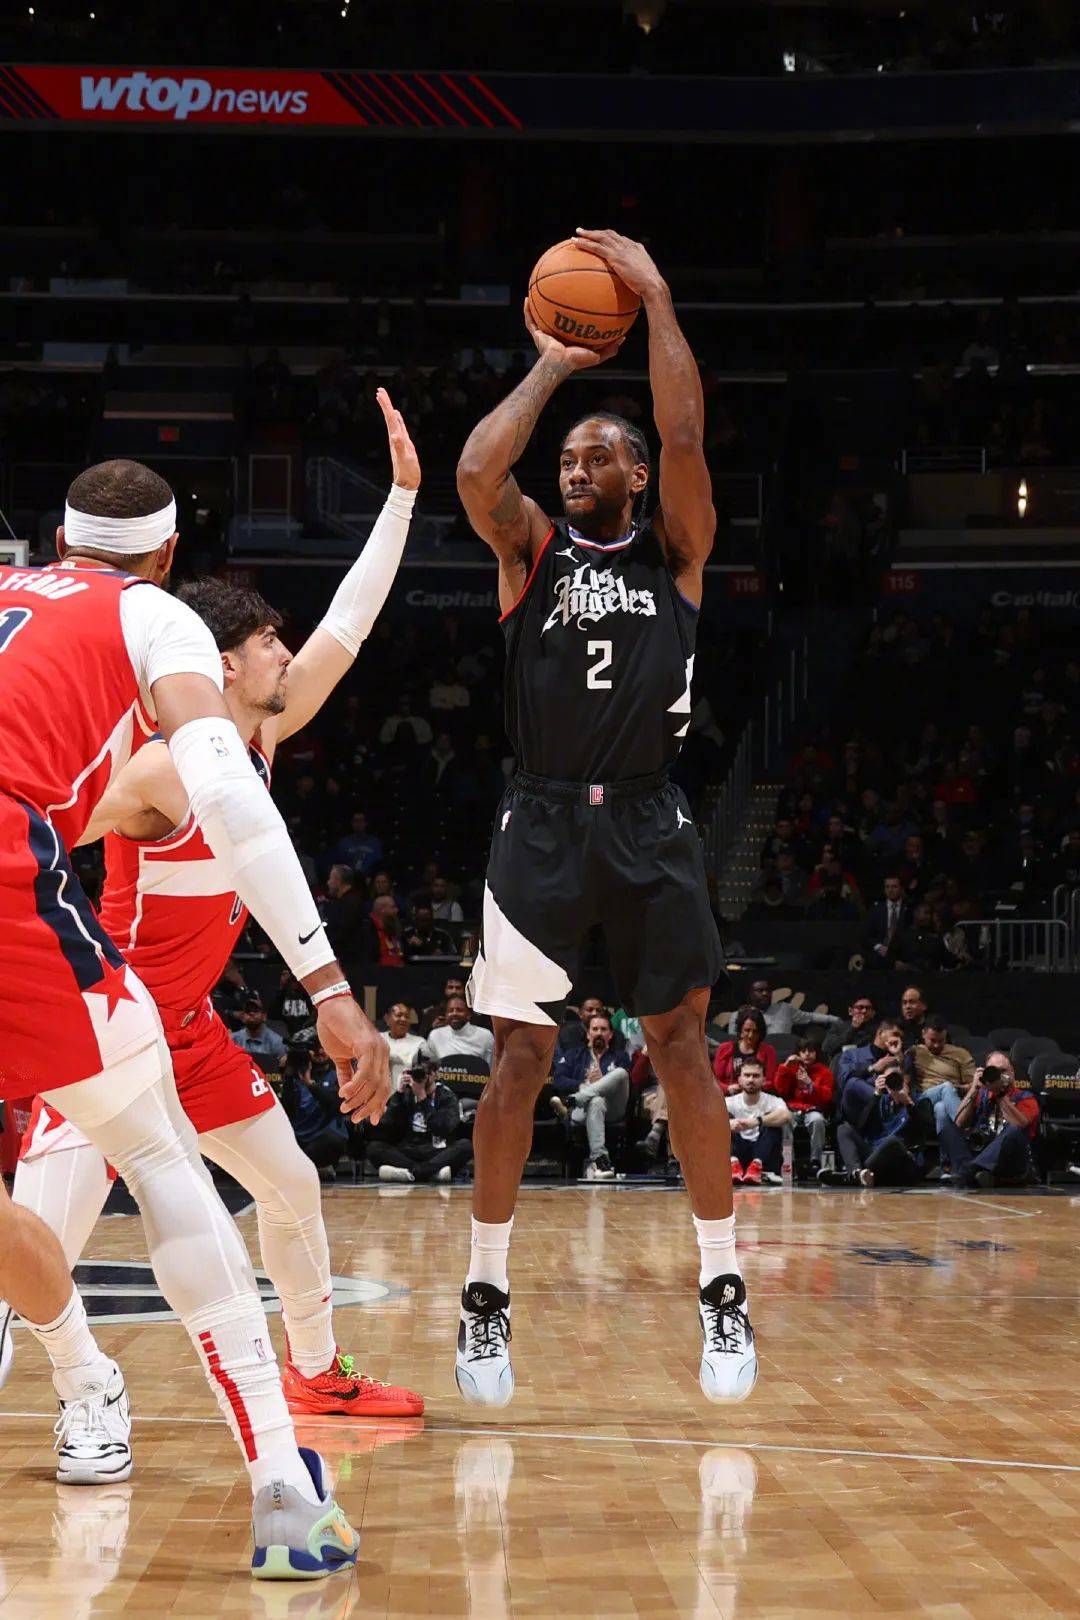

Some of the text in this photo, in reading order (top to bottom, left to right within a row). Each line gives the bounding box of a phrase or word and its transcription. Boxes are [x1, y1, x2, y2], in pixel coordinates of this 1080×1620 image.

[554, 311, 625, 340] Wilson
[570, 562, 615, 593] Los
[540, 575, 658, 638] Angeles
[586, 639, 613, 690] 2
